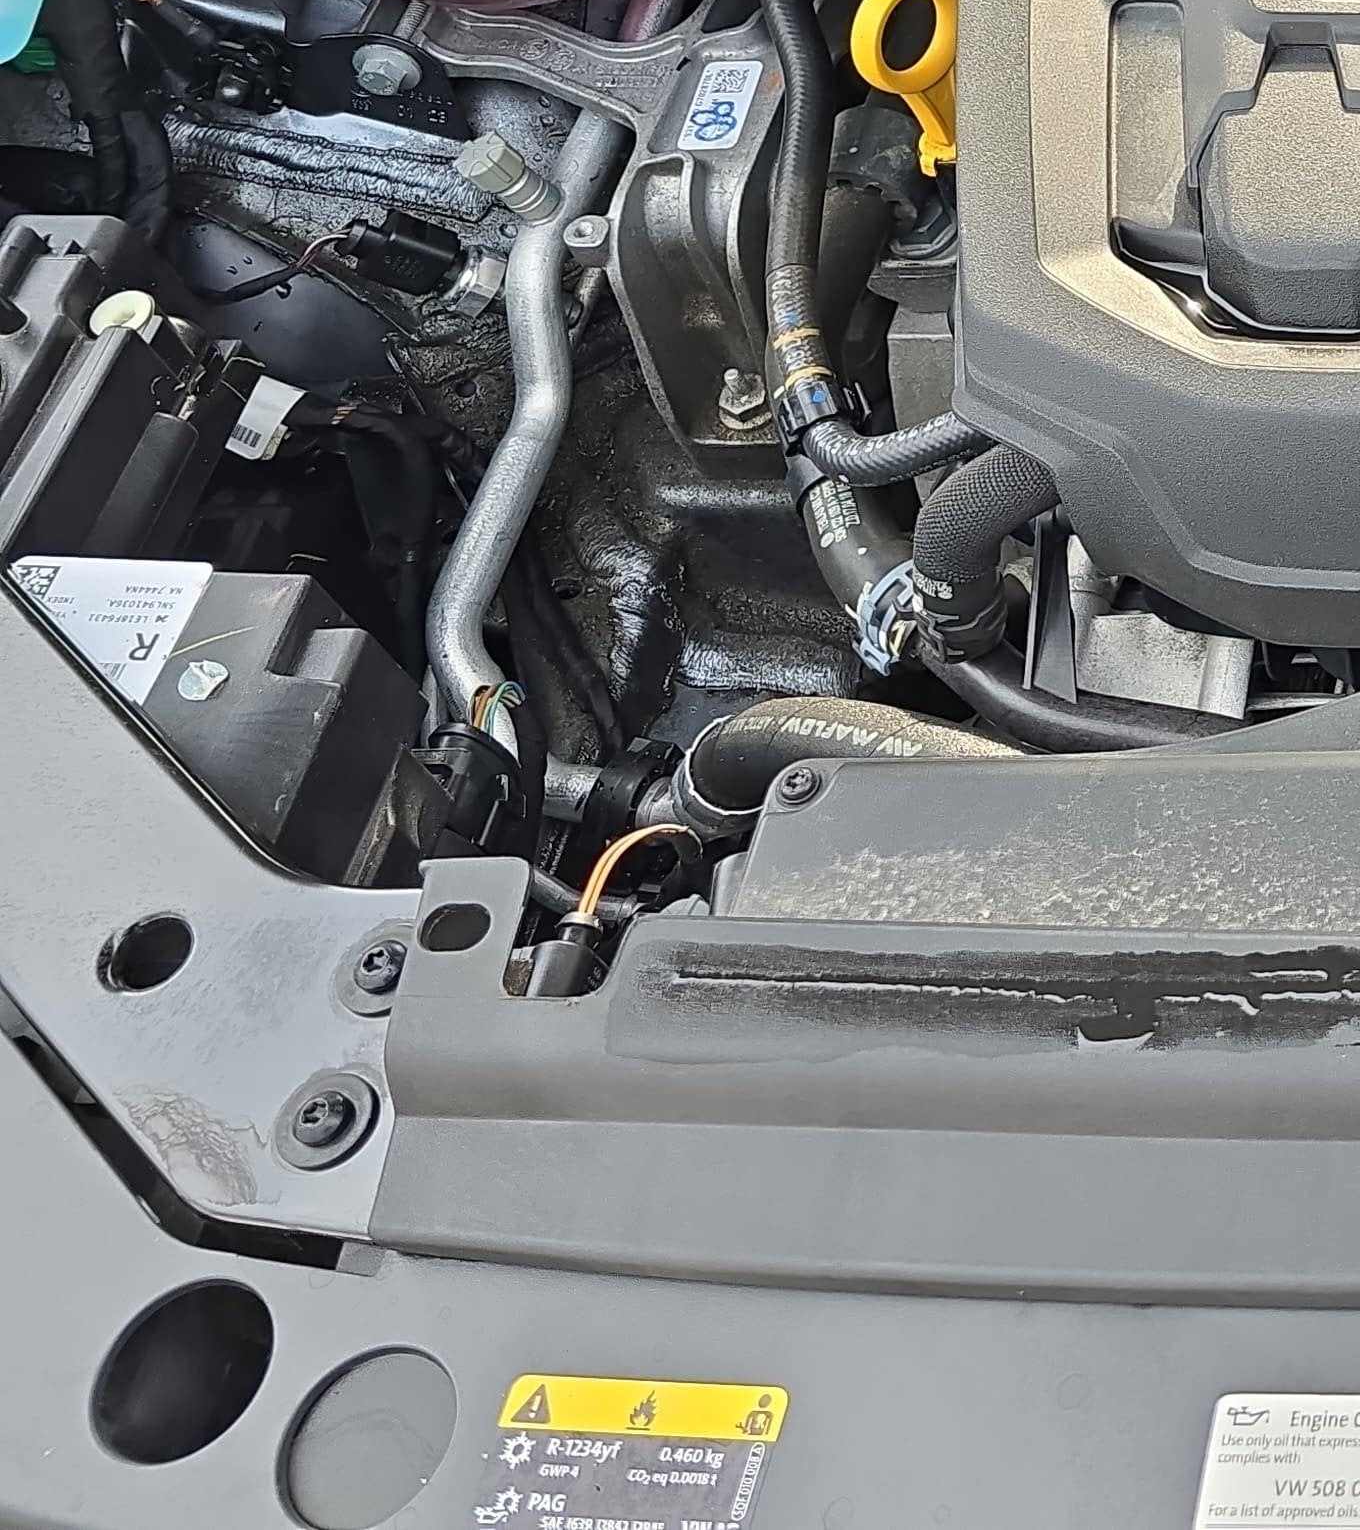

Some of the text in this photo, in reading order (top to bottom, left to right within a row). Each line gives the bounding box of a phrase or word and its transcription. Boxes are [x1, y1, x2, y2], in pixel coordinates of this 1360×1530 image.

[127, 632, 159, 660] R
[1290, 1410, 1348, 1431] Engine
[1222, 1434, 1243, 1446] Use
[1246, 1434, 1271, 1448] only
[1274, 1434, 1288, 1446] oil
[1291, 1434, 1315, 1446] that
[546, 1437, 724, 1468] R-1234yf 0.460 kg
[1218, 1452, 1300, 1465] complies with
[652, 1474, 668, 1486] eq
[1275, 1479, 1307, 1496] VW
[1311, 1479, 1345, 1496] 508
[526, 1493, 566, 1511] PAG
[1208, 1503, 1360, 1520] For a list of approved oils:
